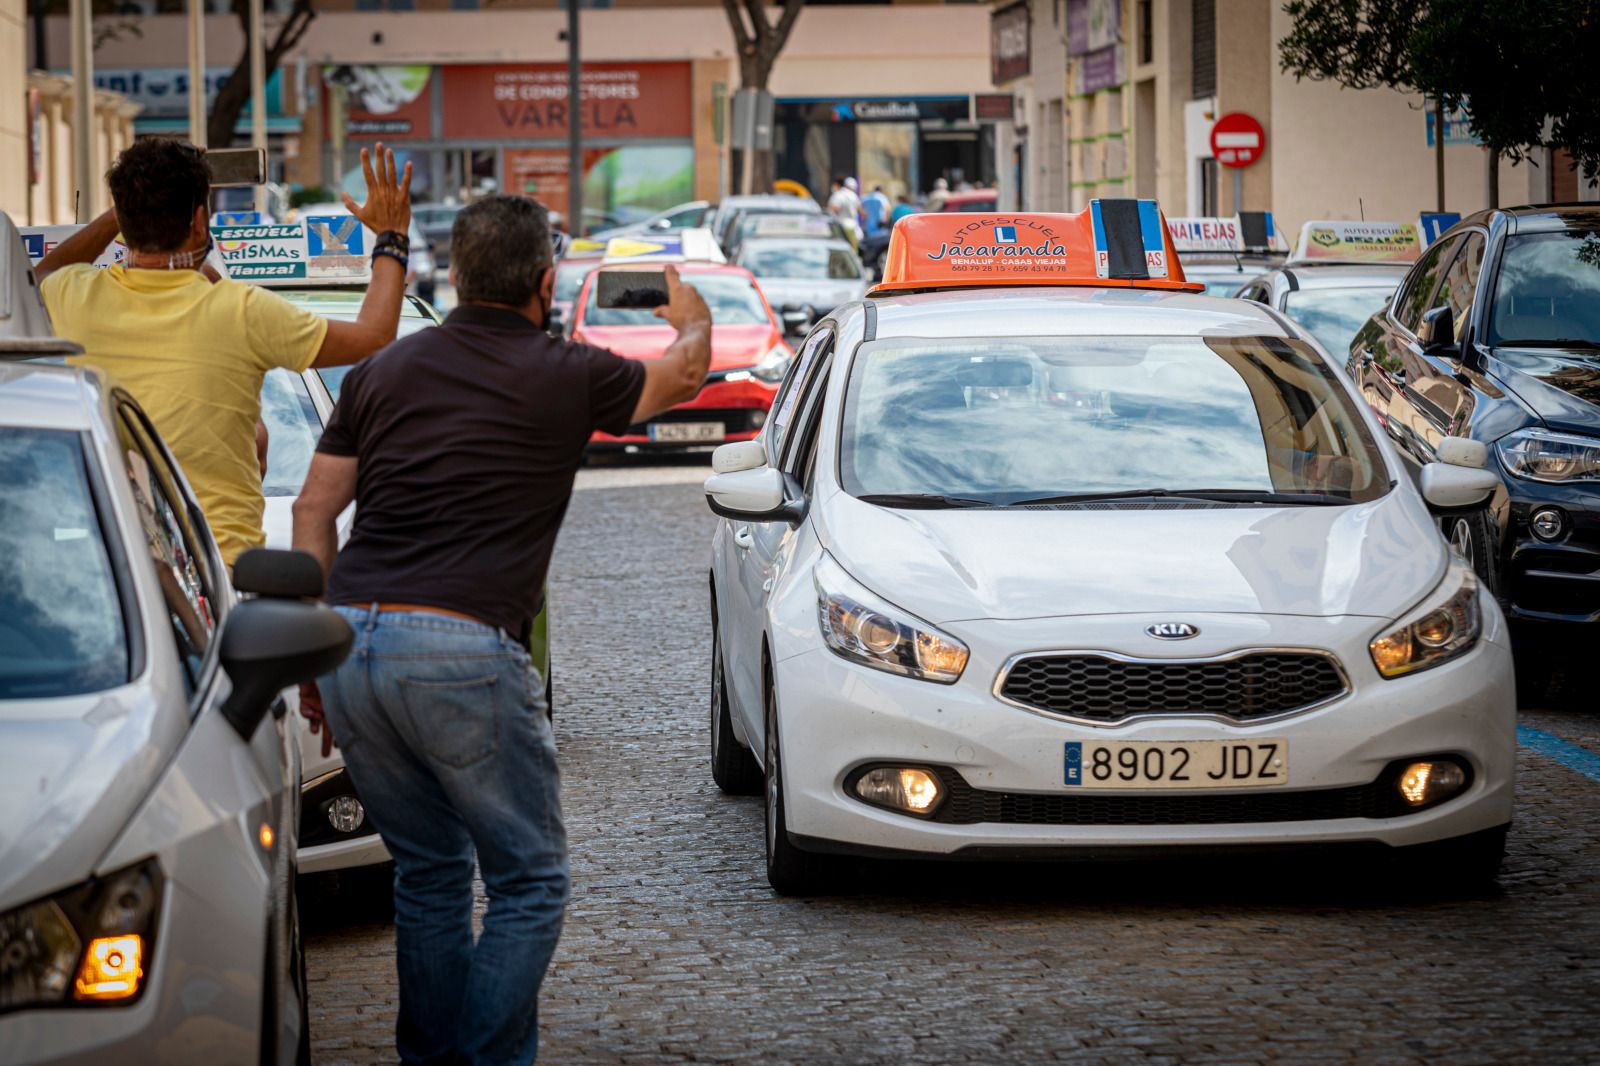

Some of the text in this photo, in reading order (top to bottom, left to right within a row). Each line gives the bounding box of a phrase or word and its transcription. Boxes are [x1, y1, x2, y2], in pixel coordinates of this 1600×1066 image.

[495, 84, 640, 100] DE CONDCTORES
[927, 240, 1068, 260] Jacaranda
[1154, 623, 1194, 636] KIA
[1091, 743, 1279, 781] 8902 JDZ
[1068, 768, 1077, 778] E
